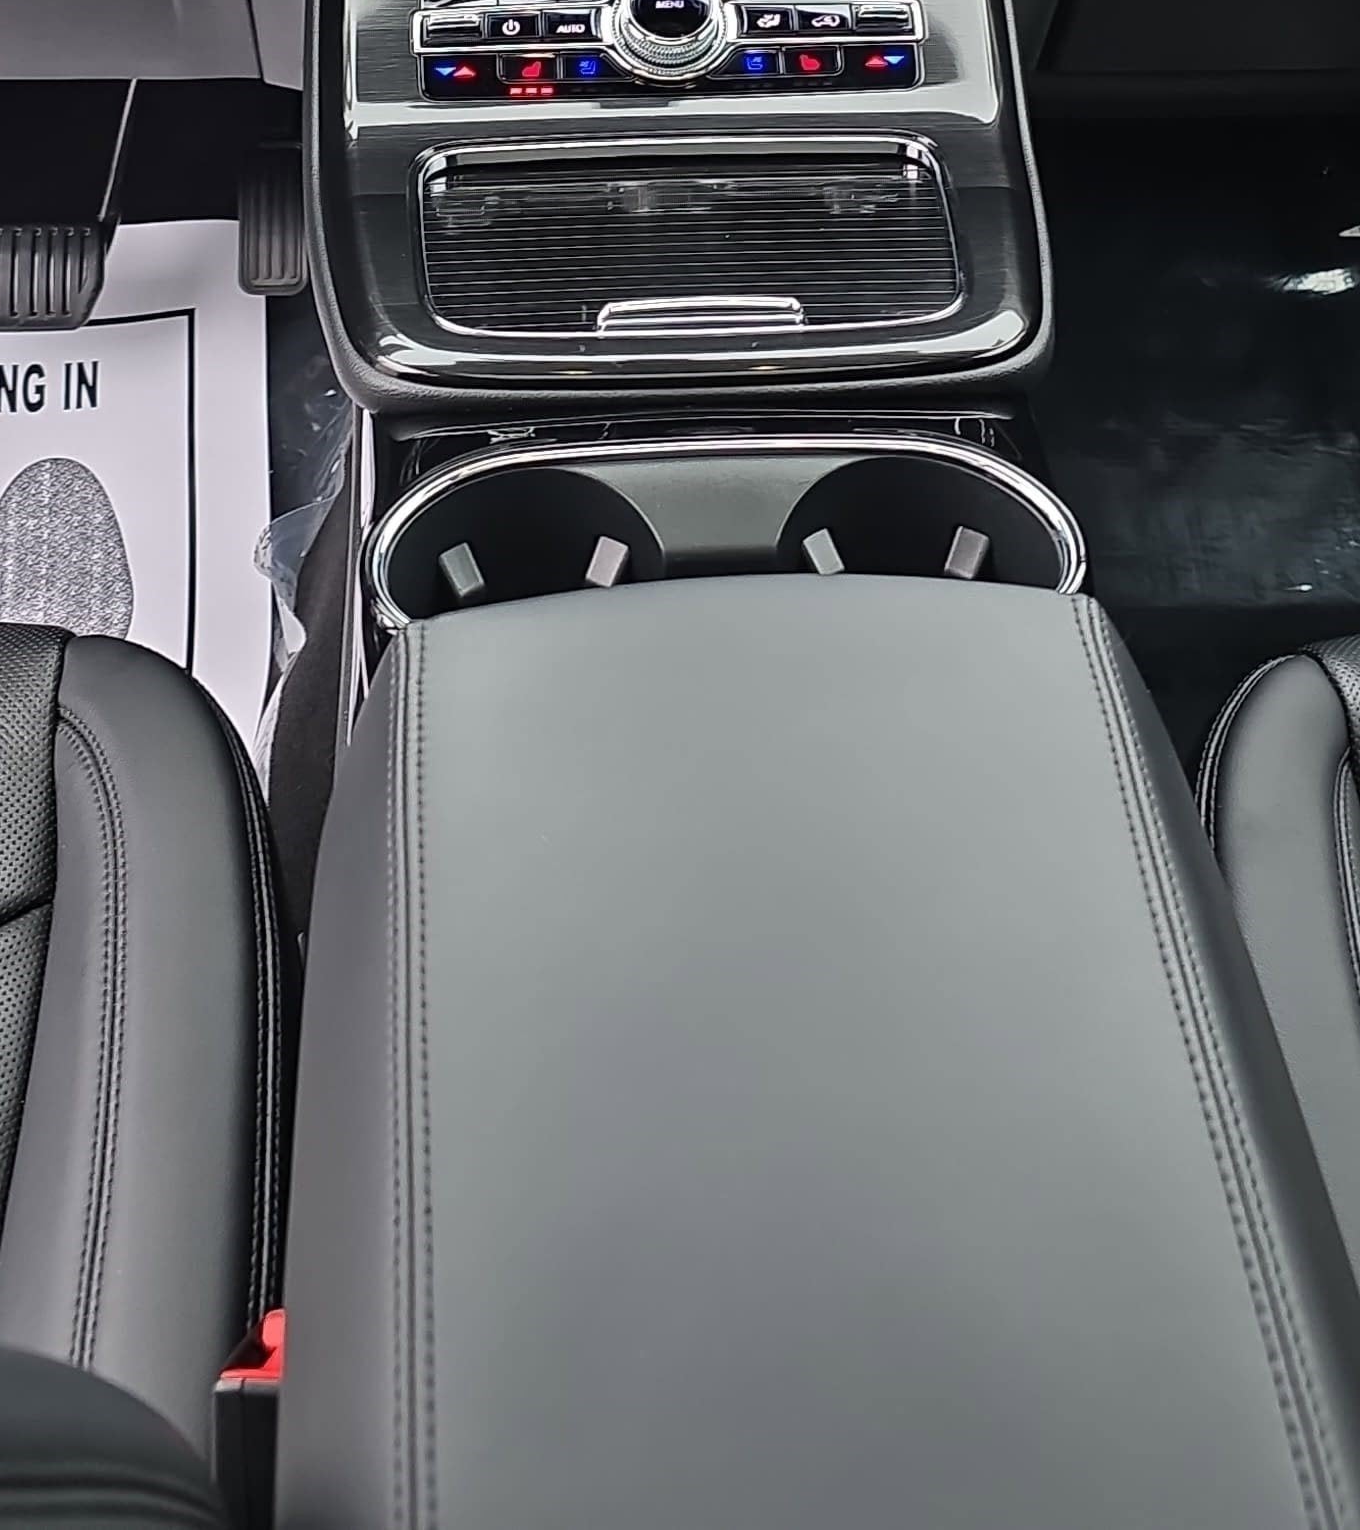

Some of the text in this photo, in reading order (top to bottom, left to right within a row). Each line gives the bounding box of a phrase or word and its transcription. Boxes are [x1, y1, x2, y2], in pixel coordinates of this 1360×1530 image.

[655, 0, 685, 9] MENU
[555, 23, 585, 33] AUTO
[64, 360, 99, 411] IN
